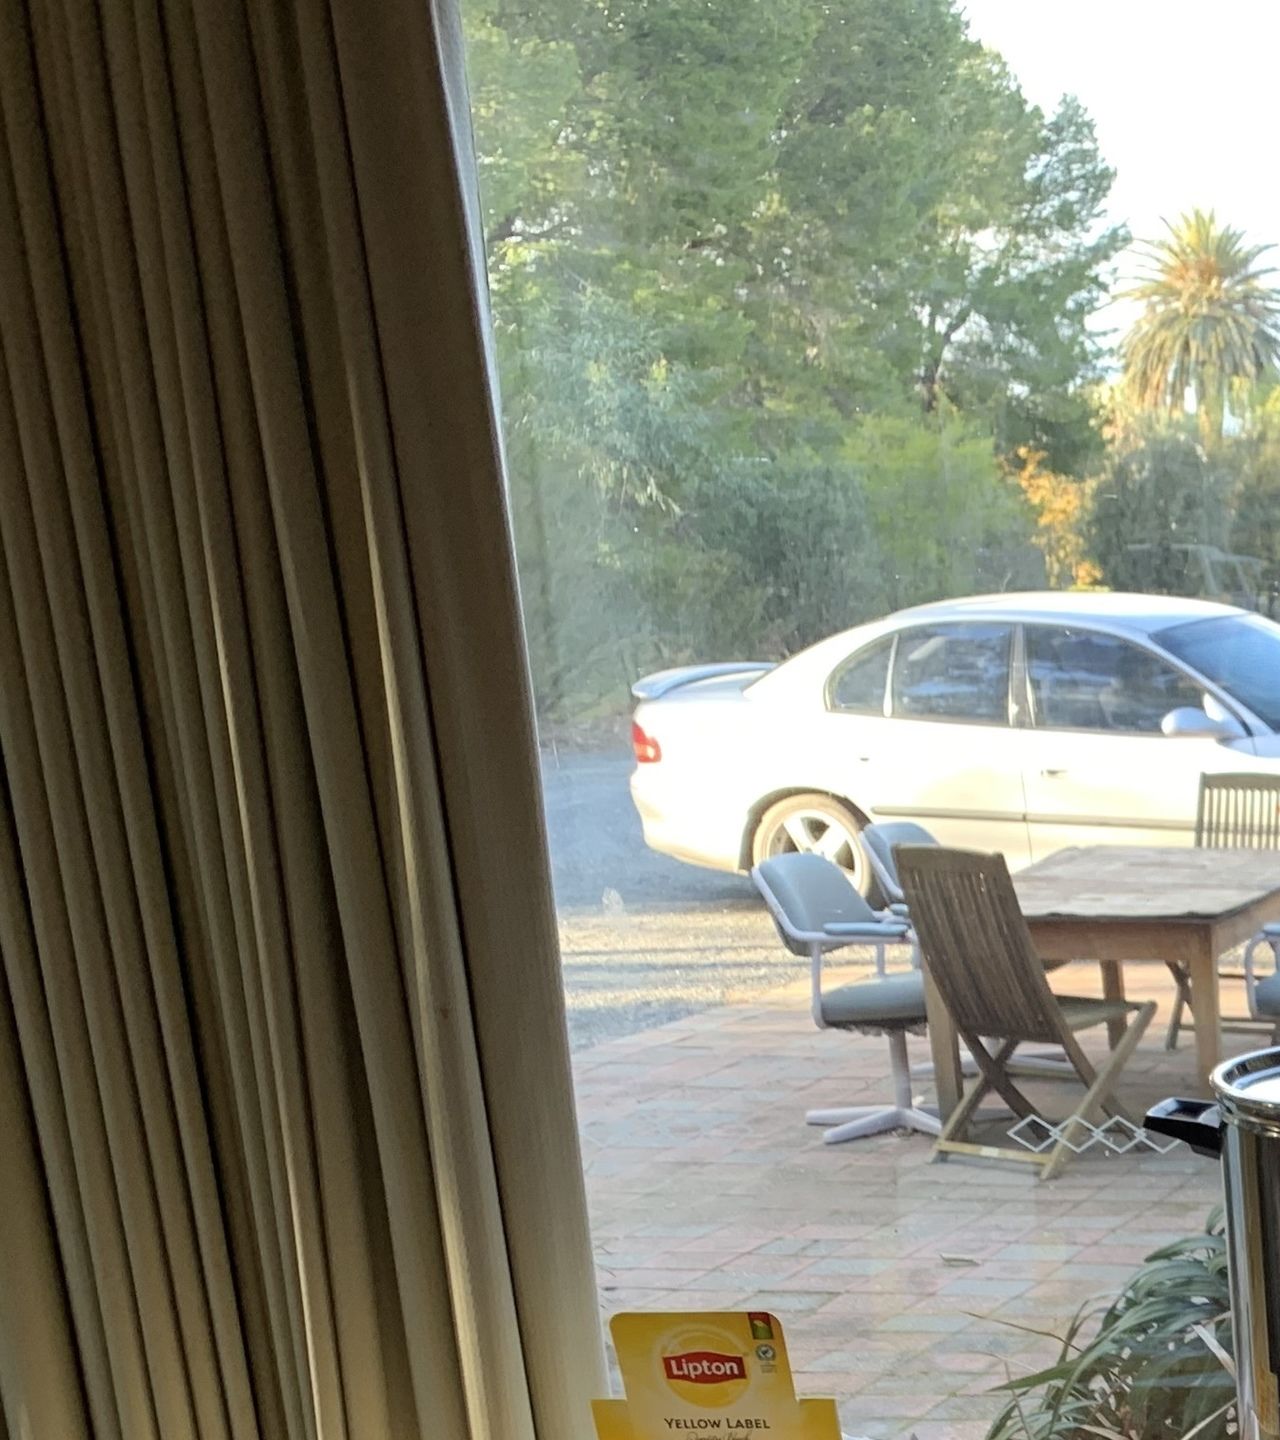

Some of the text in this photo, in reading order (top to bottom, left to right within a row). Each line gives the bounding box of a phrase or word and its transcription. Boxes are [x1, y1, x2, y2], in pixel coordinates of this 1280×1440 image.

[670, 1359, 739, 1379] Lipton
[664, 1418, 771, 1430] YELLOW LABEL
